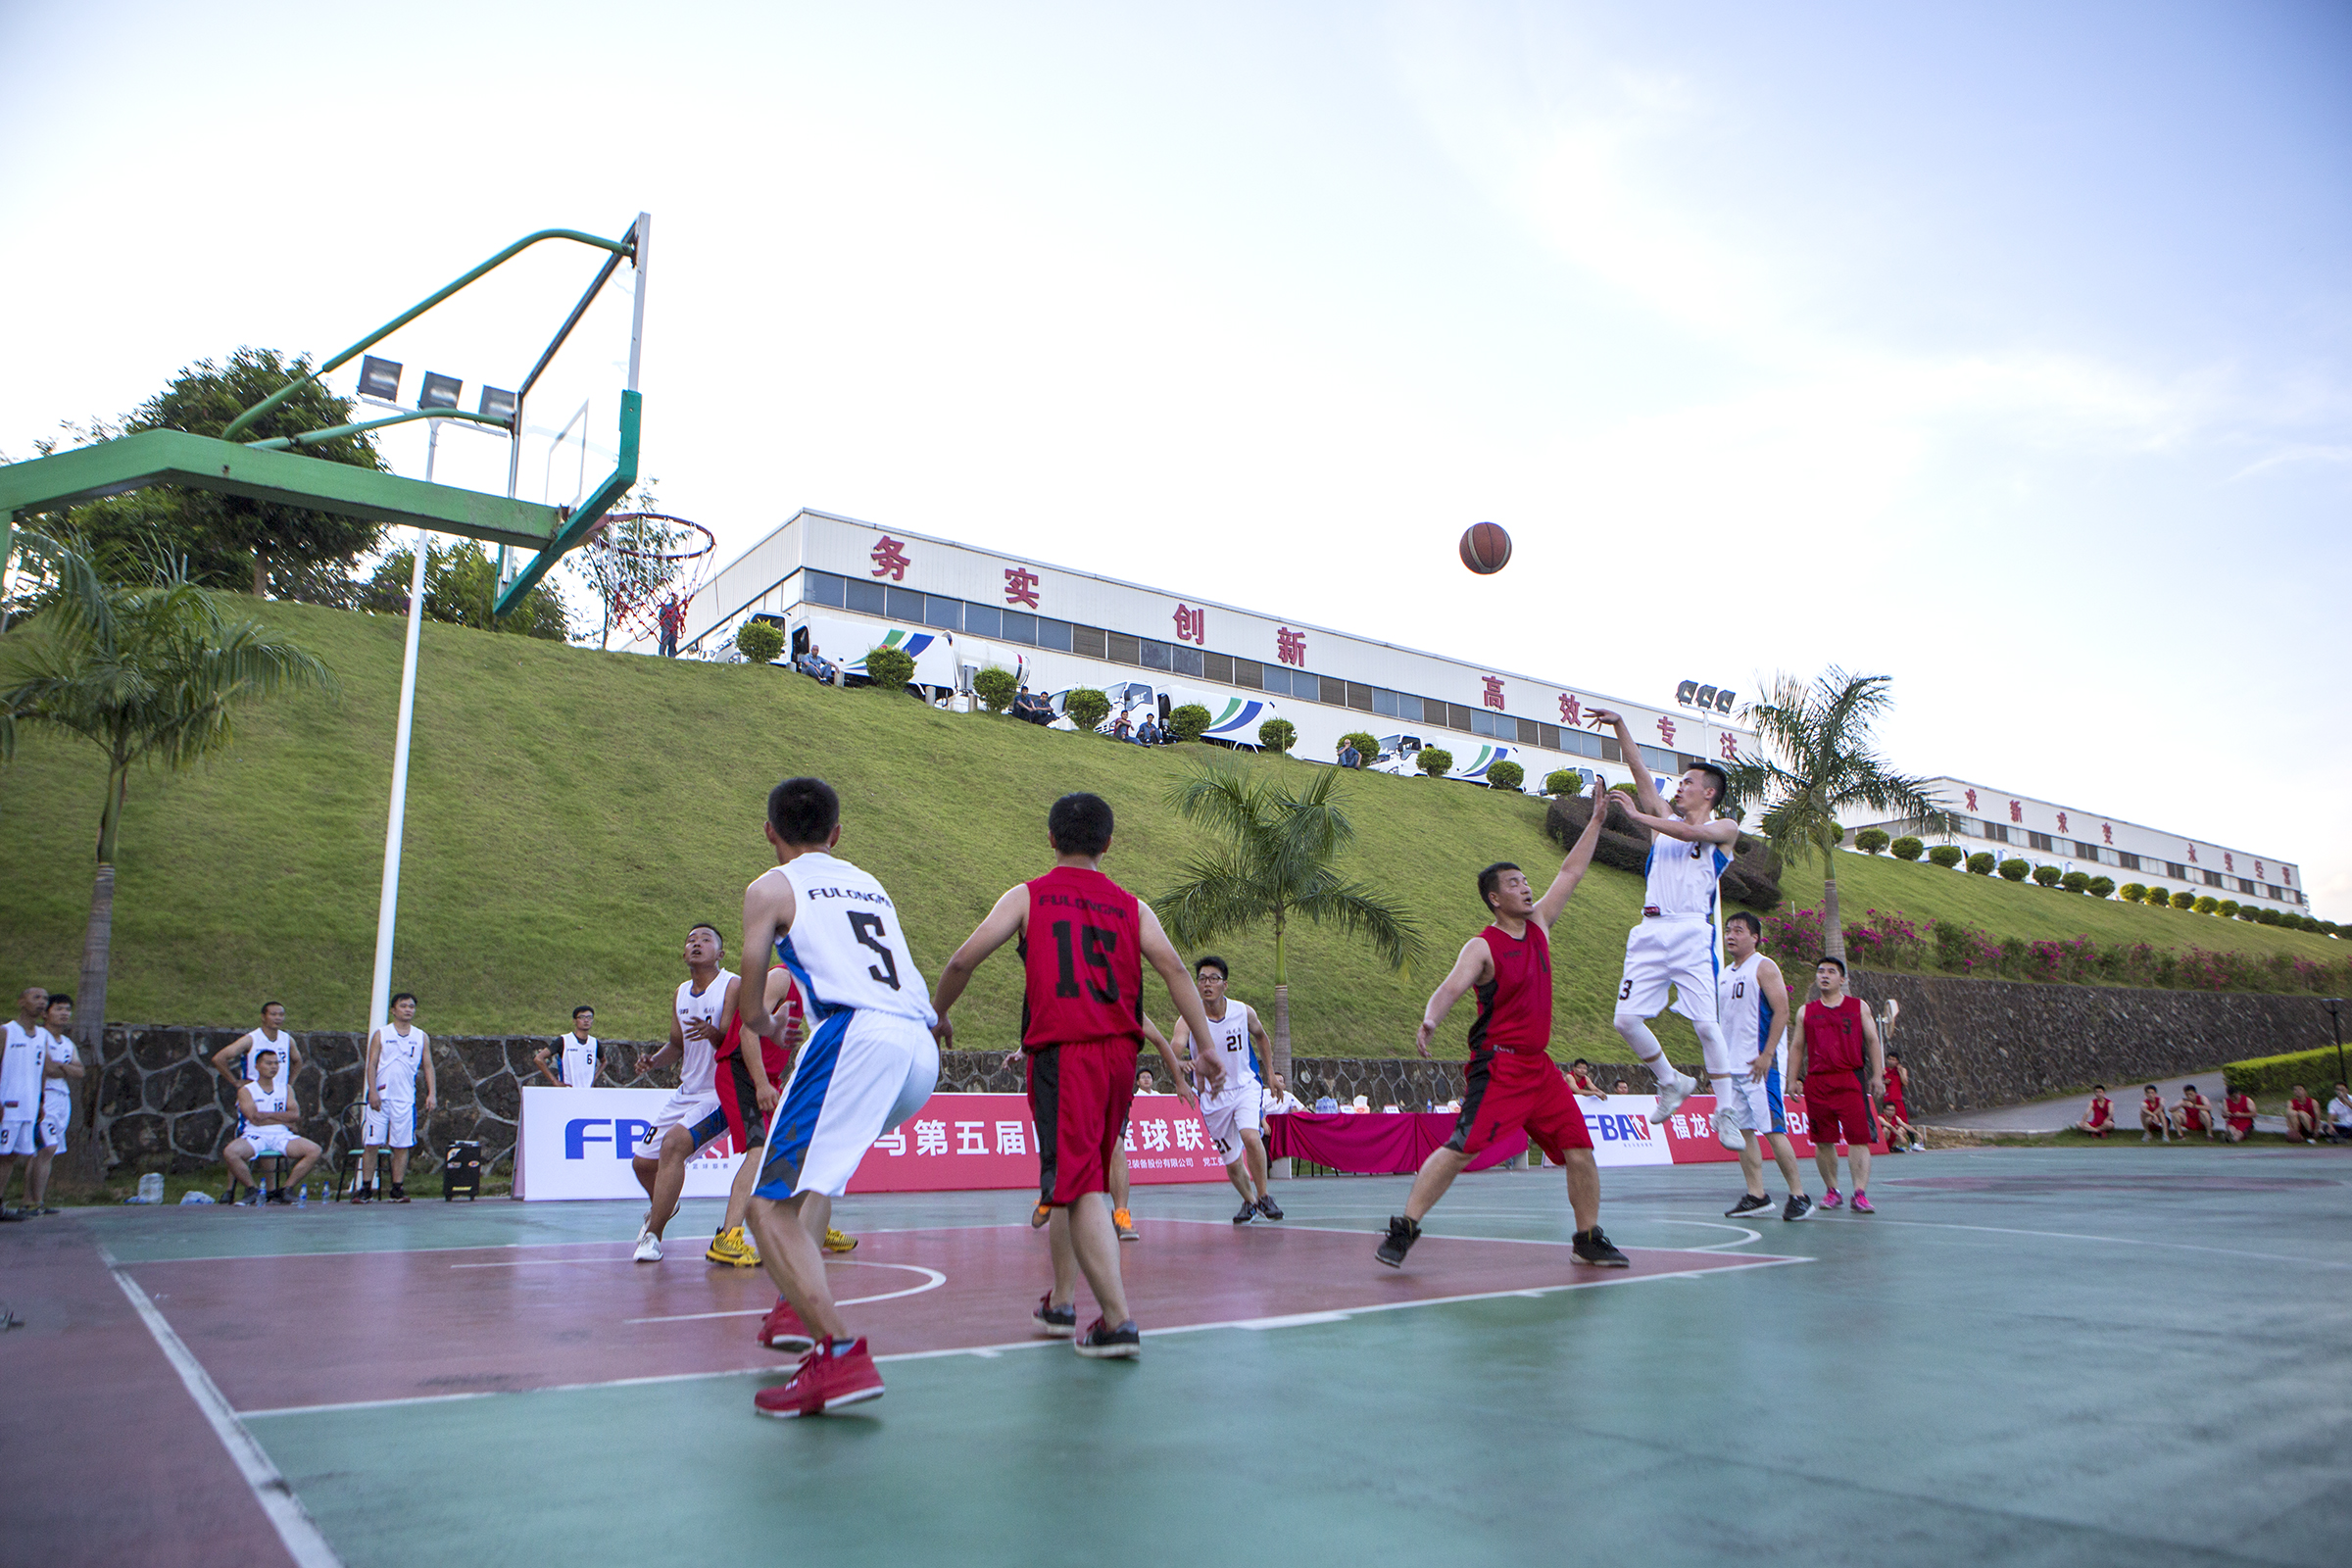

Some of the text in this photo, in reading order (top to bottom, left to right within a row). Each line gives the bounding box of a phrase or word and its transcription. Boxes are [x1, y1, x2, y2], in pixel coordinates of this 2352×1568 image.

[846, 910, 901, 991] 5
[1052, 919, 1119, 1004] 15
[1619, 979, 1634, 1001] 3
[1731, 981, 1745, 999] 10
[1225, 1033, 1243, 1053] 21
[586, 1054, 593, 1065] 6
[643, 1126, 658, 1146] 8
[1670, 1113, 1718, 1140] 福龙
